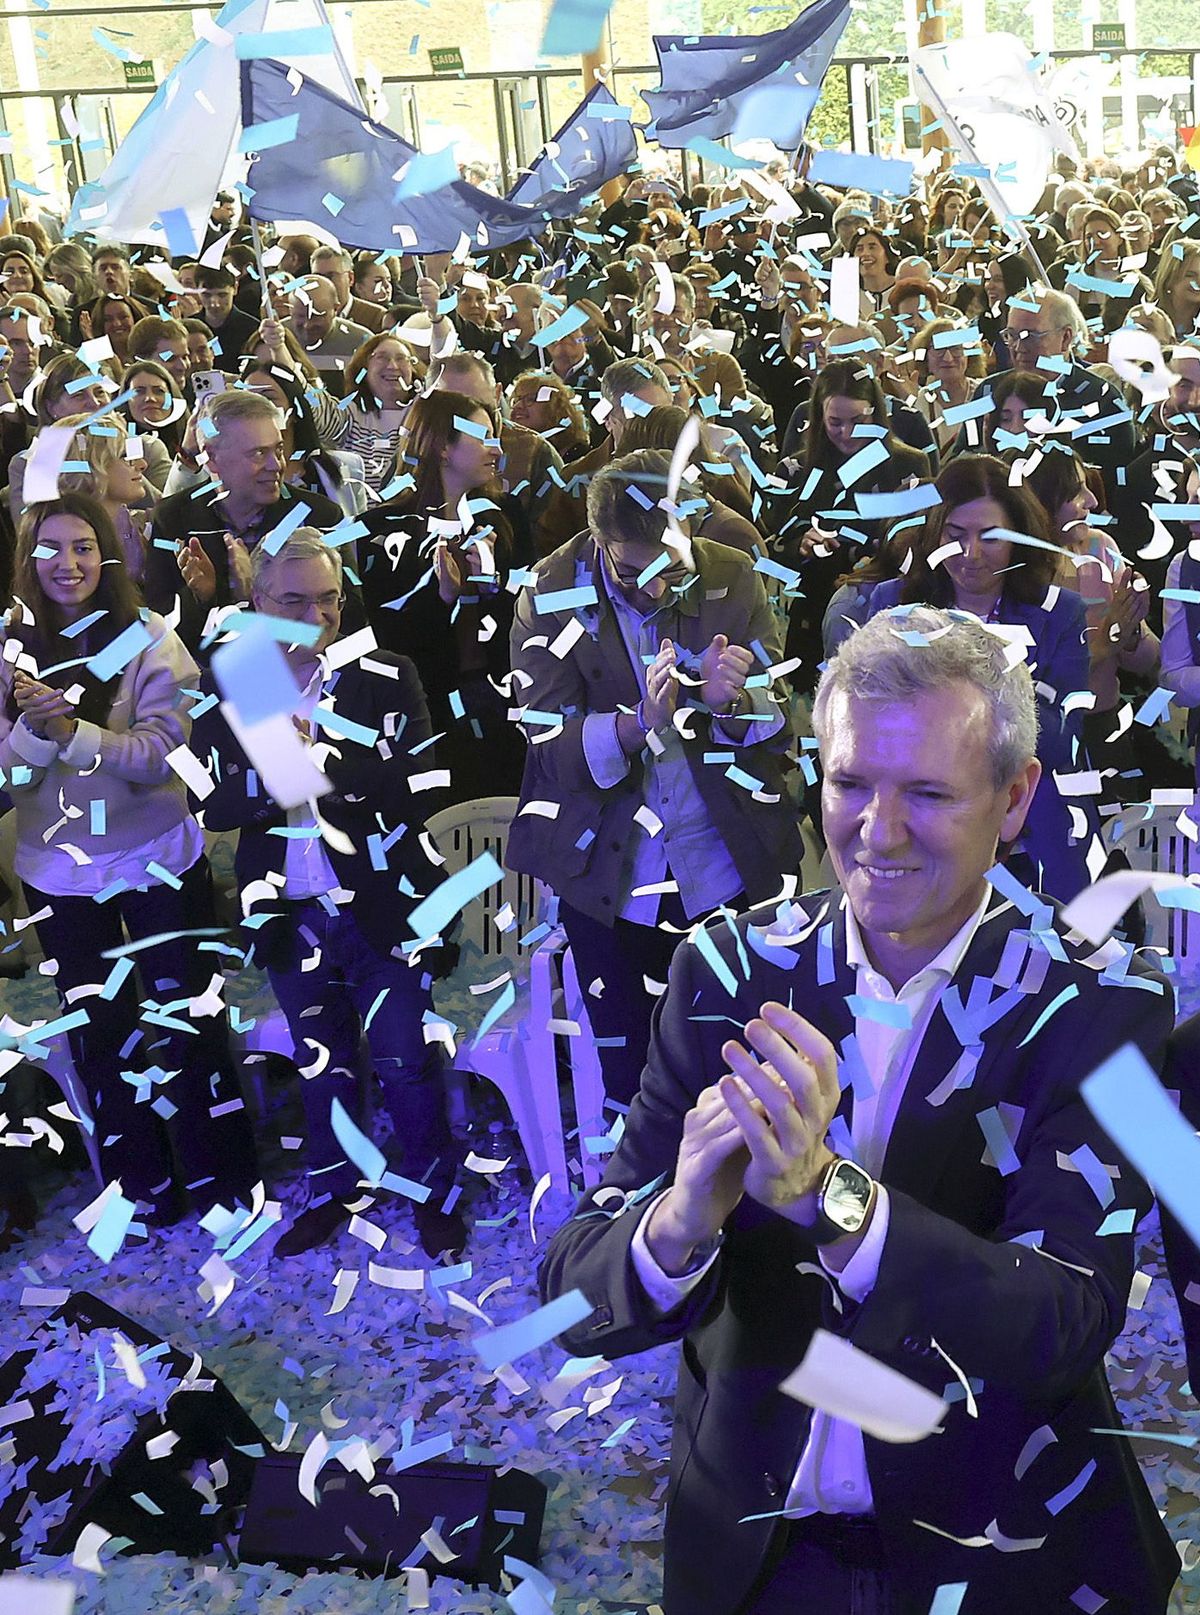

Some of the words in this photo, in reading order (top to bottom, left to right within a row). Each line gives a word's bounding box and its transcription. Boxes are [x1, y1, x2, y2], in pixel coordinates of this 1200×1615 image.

[1094, 30, 1124, 41] SAIDA
[431, 54, 461, 65] SAIDA
[125, 67, 153, 77] SAIDA
